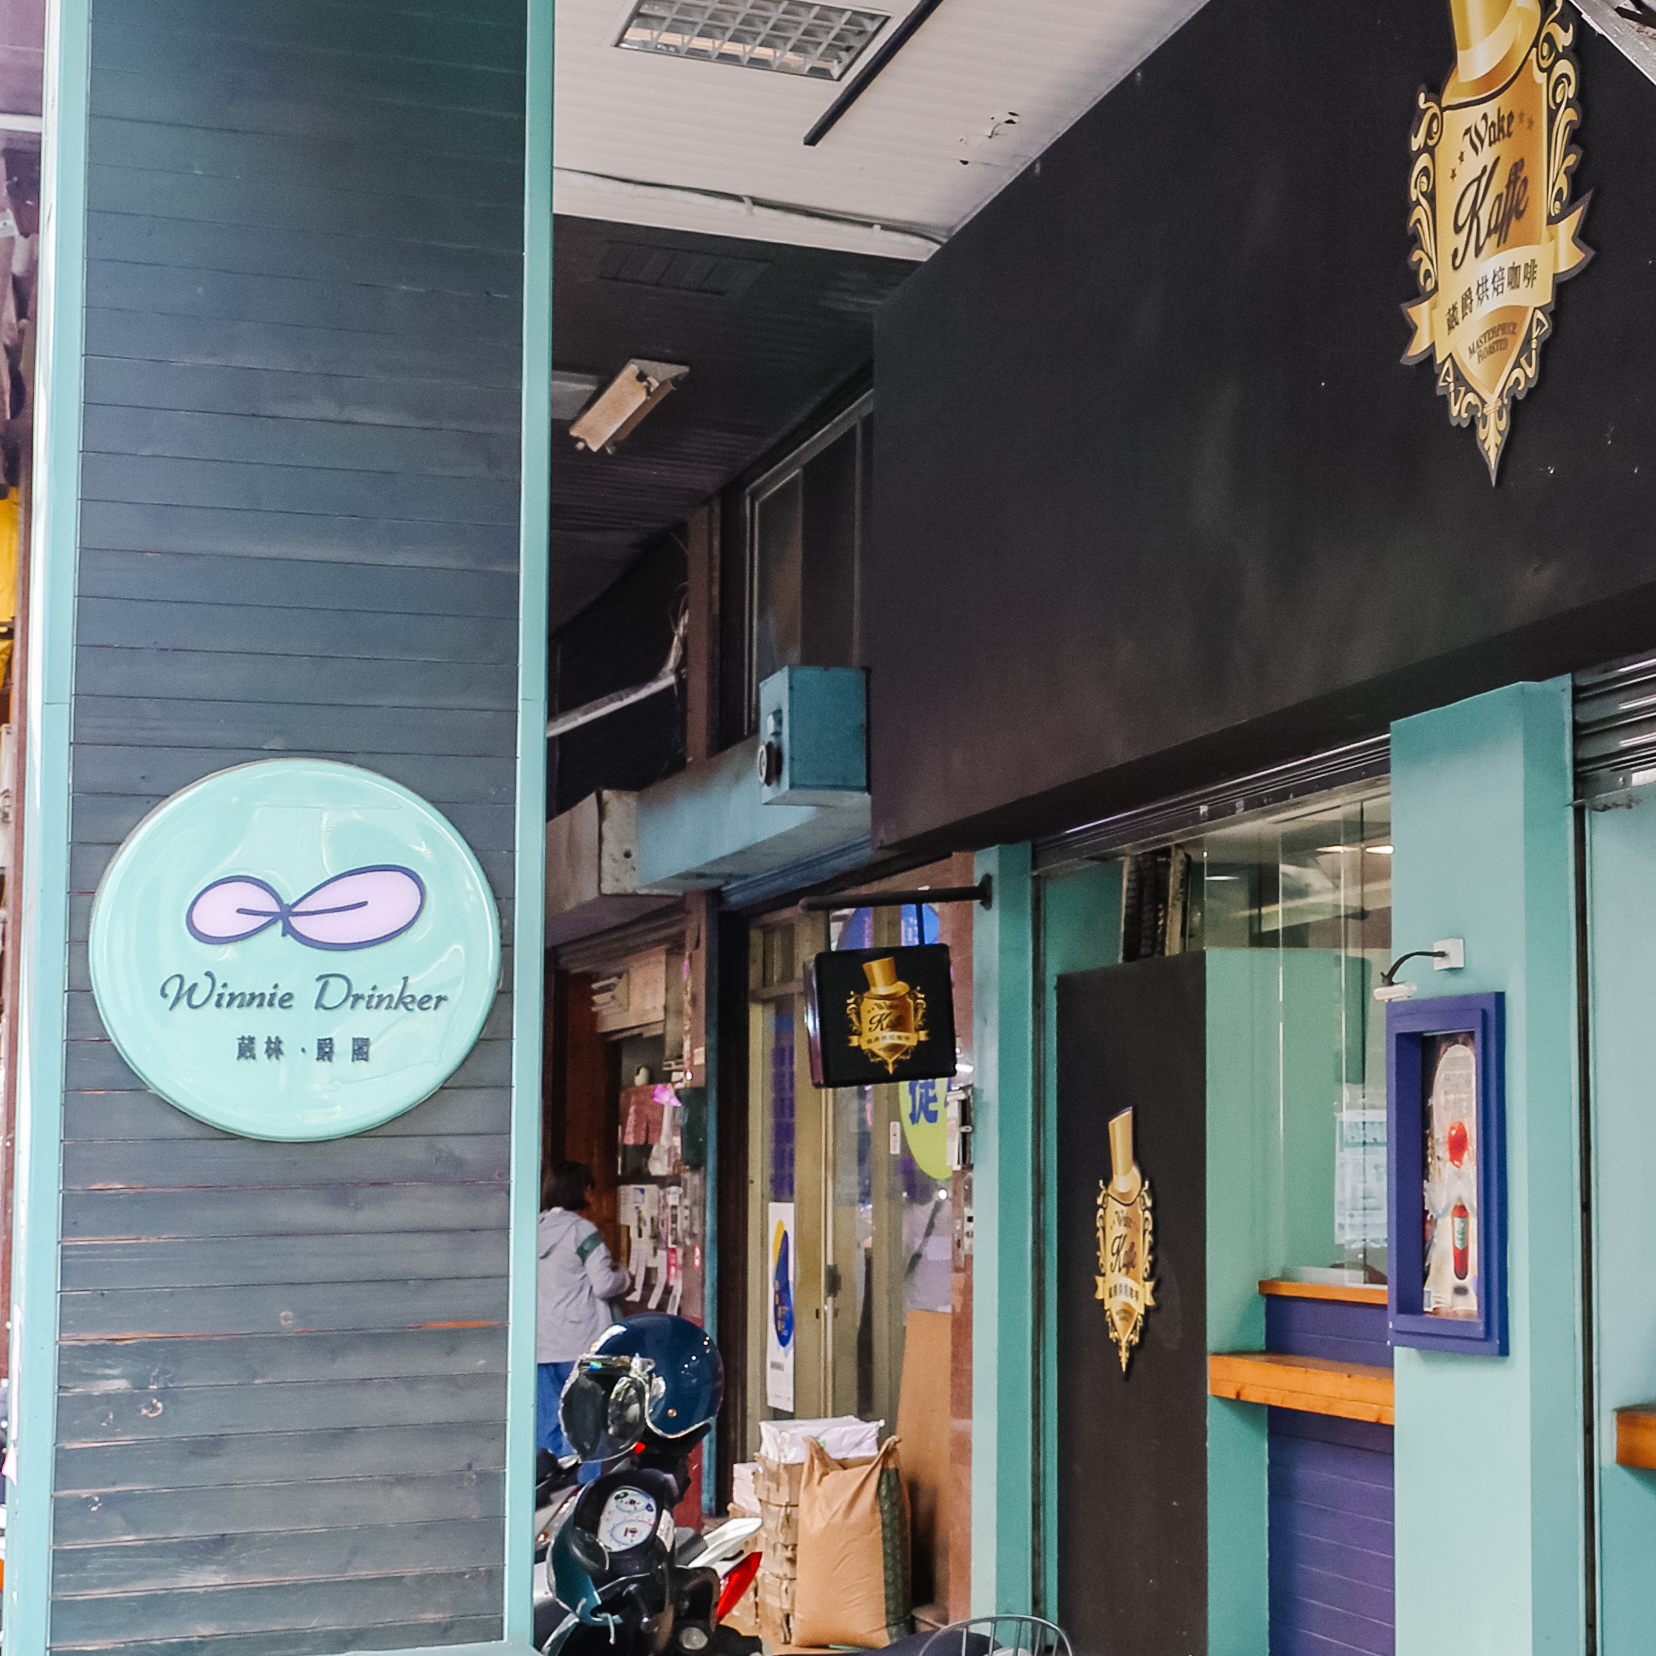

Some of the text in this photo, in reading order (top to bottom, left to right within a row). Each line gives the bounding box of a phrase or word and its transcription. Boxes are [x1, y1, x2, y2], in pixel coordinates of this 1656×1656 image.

[1462, 107, 1515, 156] Wake
[1452, 155, 1529, 271] Kaffe
[159, 970, 449, 1014] Winnie Drinker
